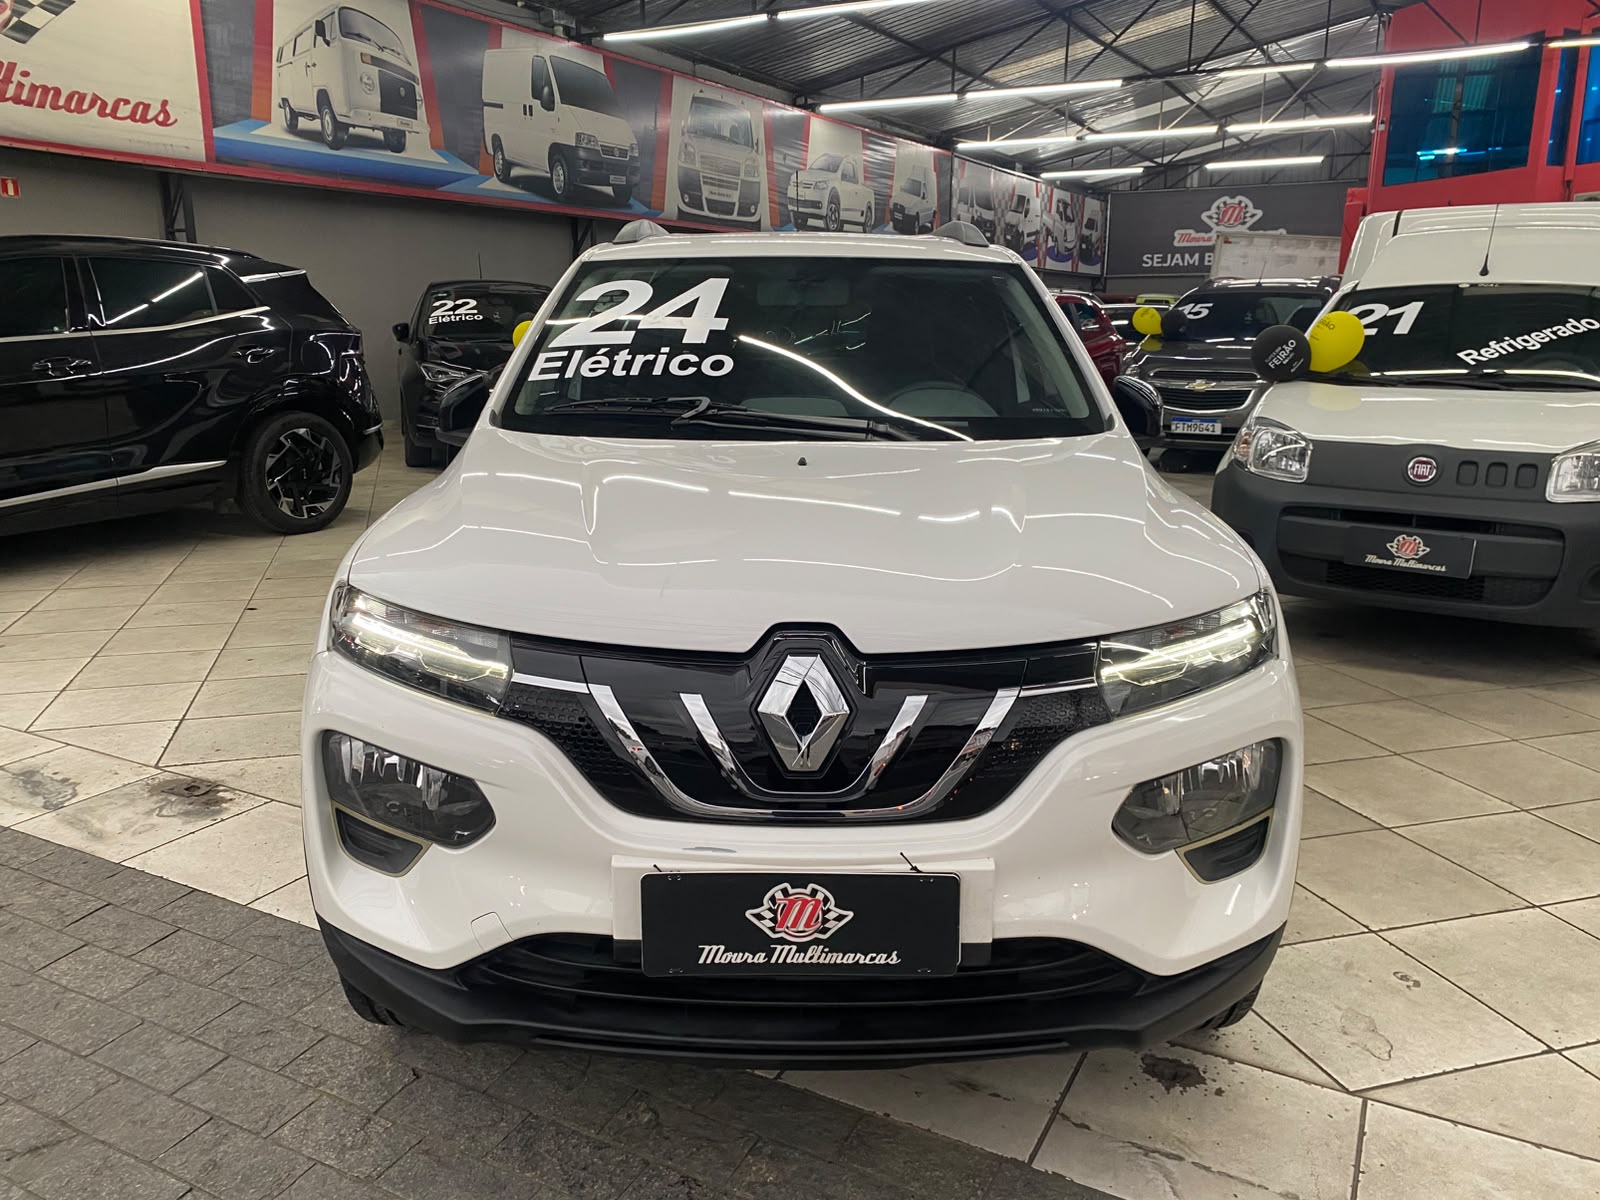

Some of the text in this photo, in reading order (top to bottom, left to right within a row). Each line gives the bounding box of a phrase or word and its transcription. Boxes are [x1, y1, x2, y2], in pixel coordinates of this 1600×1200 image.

[1177, 232, 1213, 244] Moura
[1142, 252, 1199, 267] SEJAM
[430, 298, 478, 317] 22
[548, 277, 730, 348] 24
[1178, 303, 1214, 320] 15
[428, 314, 484, 325] Elétrico
[1347, 301, 1424, 336] 21
[1456, 317, 1600, 366] Refrigerado
[1268, 339, 1297, 369] FEIRÃO
[527, 346, 735, 382] Elétrico
[1413, 463, 1432, 476] FIAT
[1364, 554, 1447, 572] Moura Multimarcas
[697, 944, 902, 965] Moura Multimarcas
